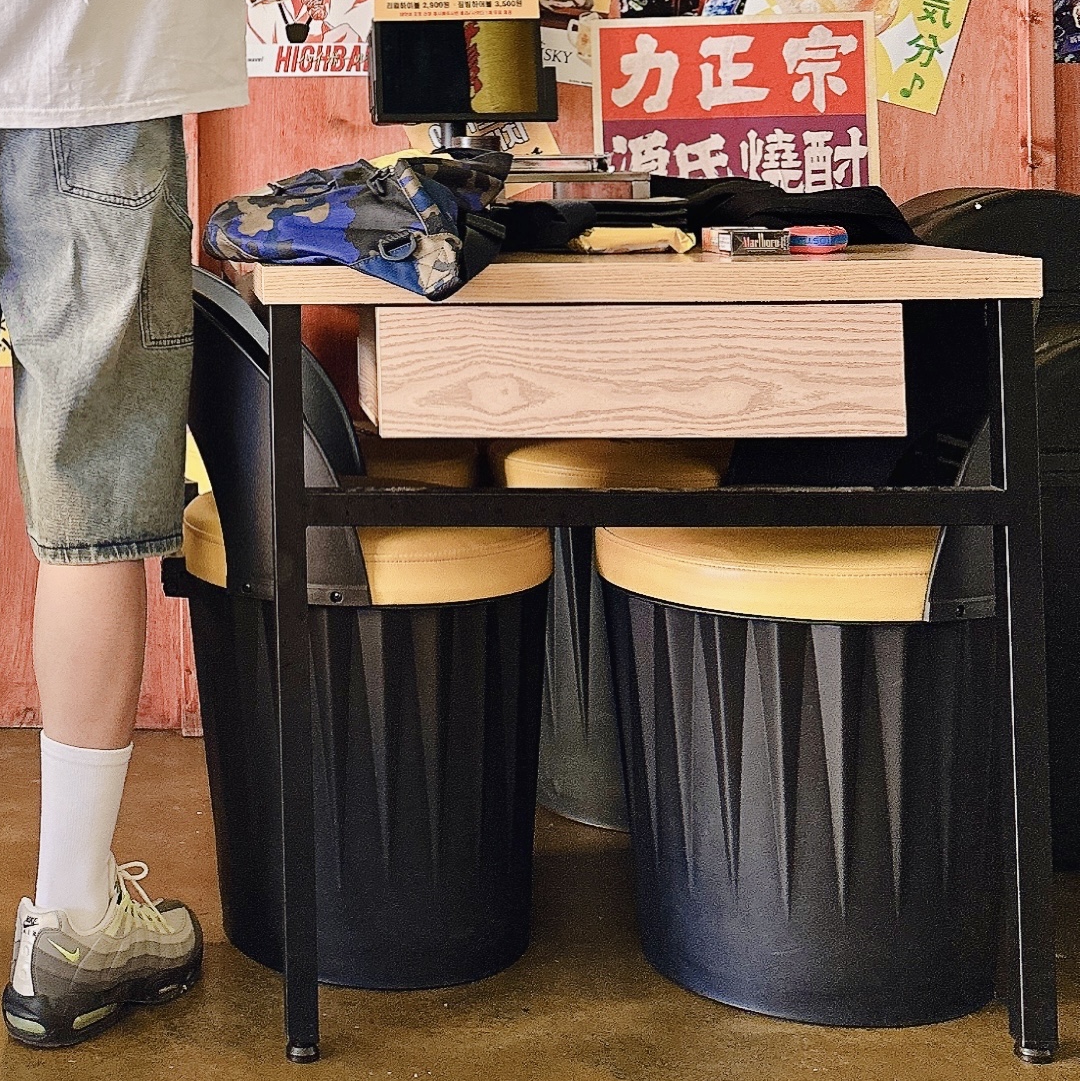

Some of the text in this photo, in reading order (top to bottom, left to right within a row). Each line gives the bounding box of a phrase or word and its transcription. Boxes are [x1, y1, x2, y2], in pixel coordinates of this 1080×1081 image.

[541, 48, 572, 63] SKY
[611, 25, 858, 112] 力正宗
